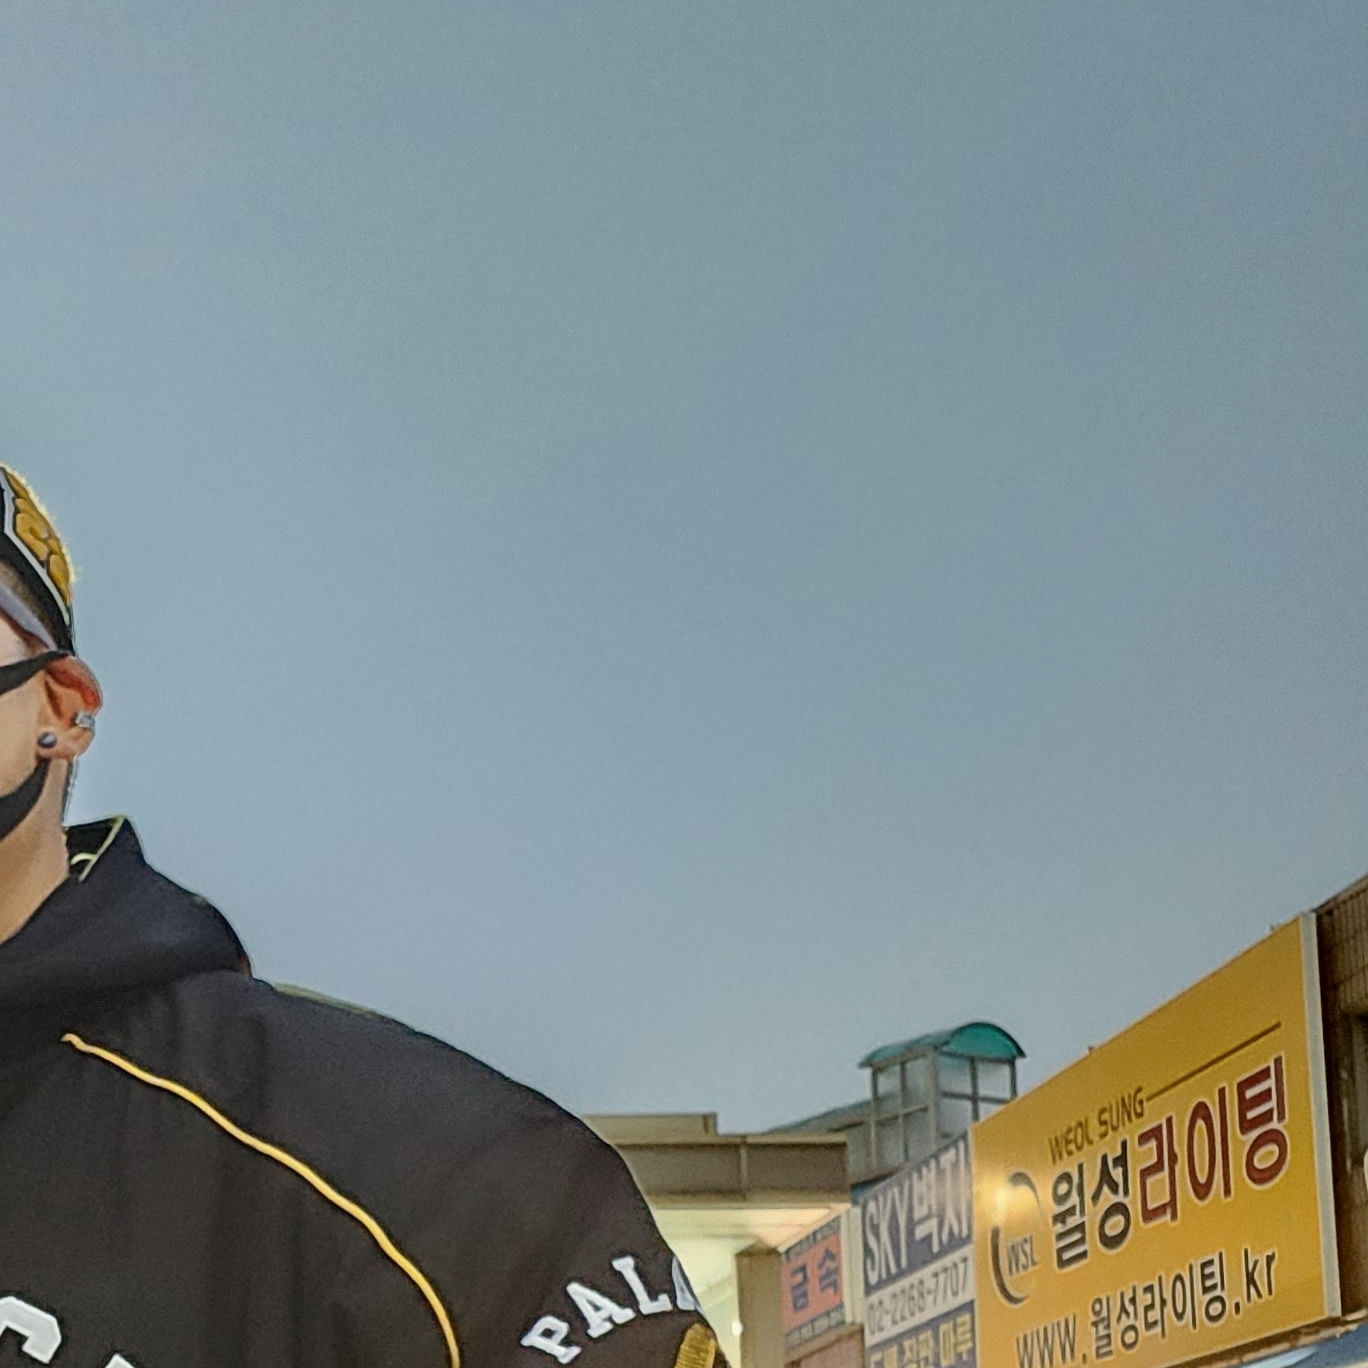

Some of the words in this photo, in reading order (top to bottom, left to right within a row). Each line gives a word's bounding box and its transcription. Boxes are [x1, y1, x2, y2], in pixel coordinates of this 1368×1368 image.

[1048, 1117, 1094, 1164] WEOL
[1097, 1087, 1146, 1138] SUNG
[1051, 1055, 1289, 1270] 월성라이팅
[865, 1138, 969, 1286] SKY벽지
[1006, 1233, 1040, 1277] WSL
[867, 1256, 968, 1335] 02-2268-7707
